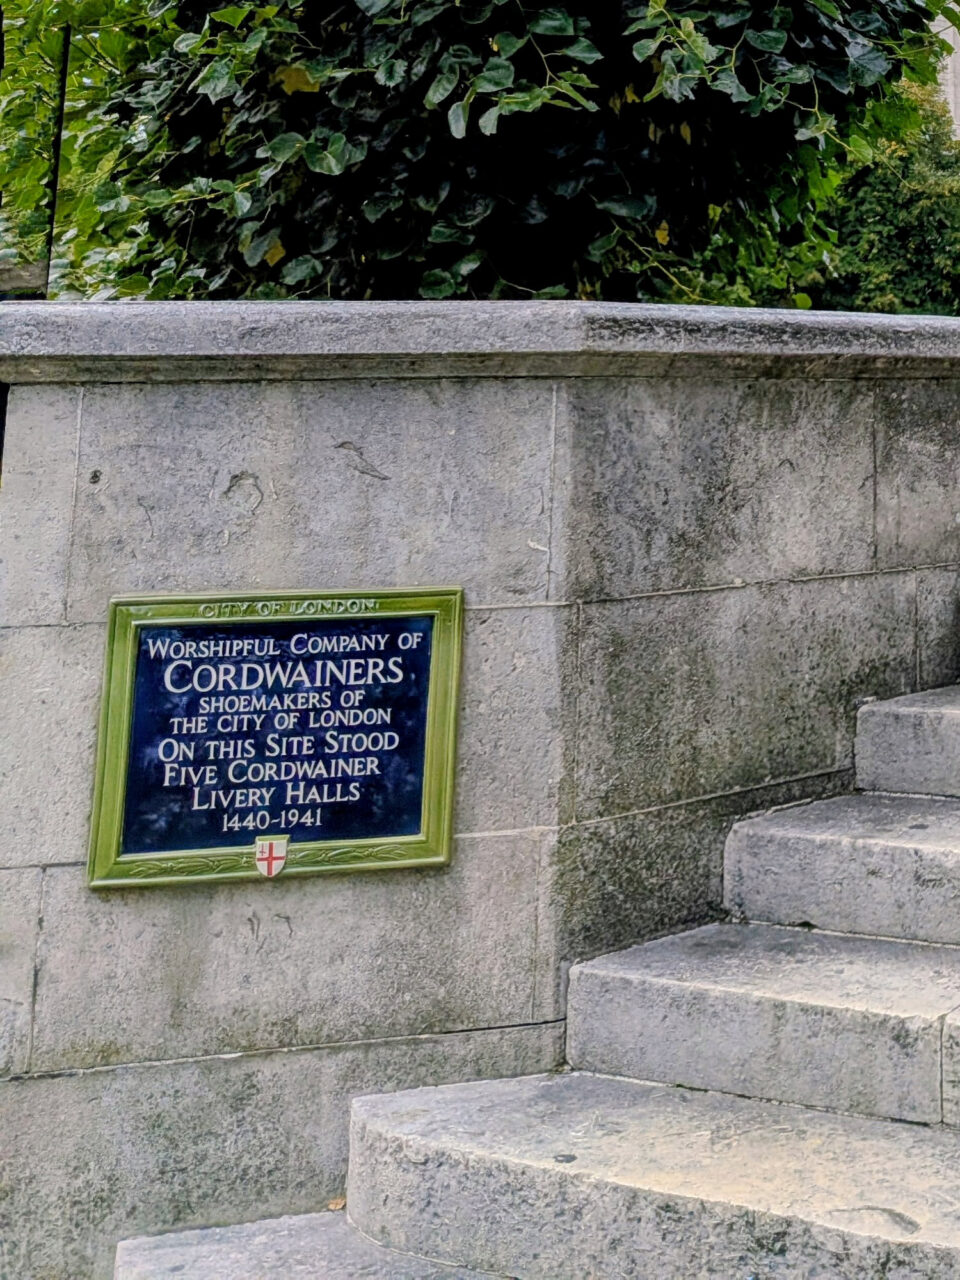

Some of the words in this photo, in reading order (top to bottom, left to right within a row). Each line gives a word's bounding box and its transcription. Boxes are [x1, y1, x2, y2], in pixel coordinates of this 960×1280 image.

[198, 602, 250, 618] CITY
[256, 601, 282, 615] OF
[289, 599, 379, 615] LONDON
[147, 637, 280, 659] WORSHIPFUL
[290, 633, 390, 653] COMPANY
[397, 631, 423, 649] OF
[164, 657, 404, 693] CORDWAINERS
[199, 691, 331, 713] SHOEMAKERS
[340, 690, 365, 707] OF
[170, 717, 208, 734] THE
[217, 714, 266, 732] CITY
[274, 713, 300, 729] OF
[309, 708, 392, 728] LONDON
[158, 739, 195, 763] ON
[206, 740, 256, 759] THIS
[266, 734, 314, 757] SITE
[324, 731, 399, 754] STOOD
[163, 763, 217, 787] FIVE
[227, 757, 381, 783] CORDWAINER
[191, 786, 276, 810] LIVERY
[285, 781, 361, 804] HALLS
[222, 808, 322, 832] 1440-1941
